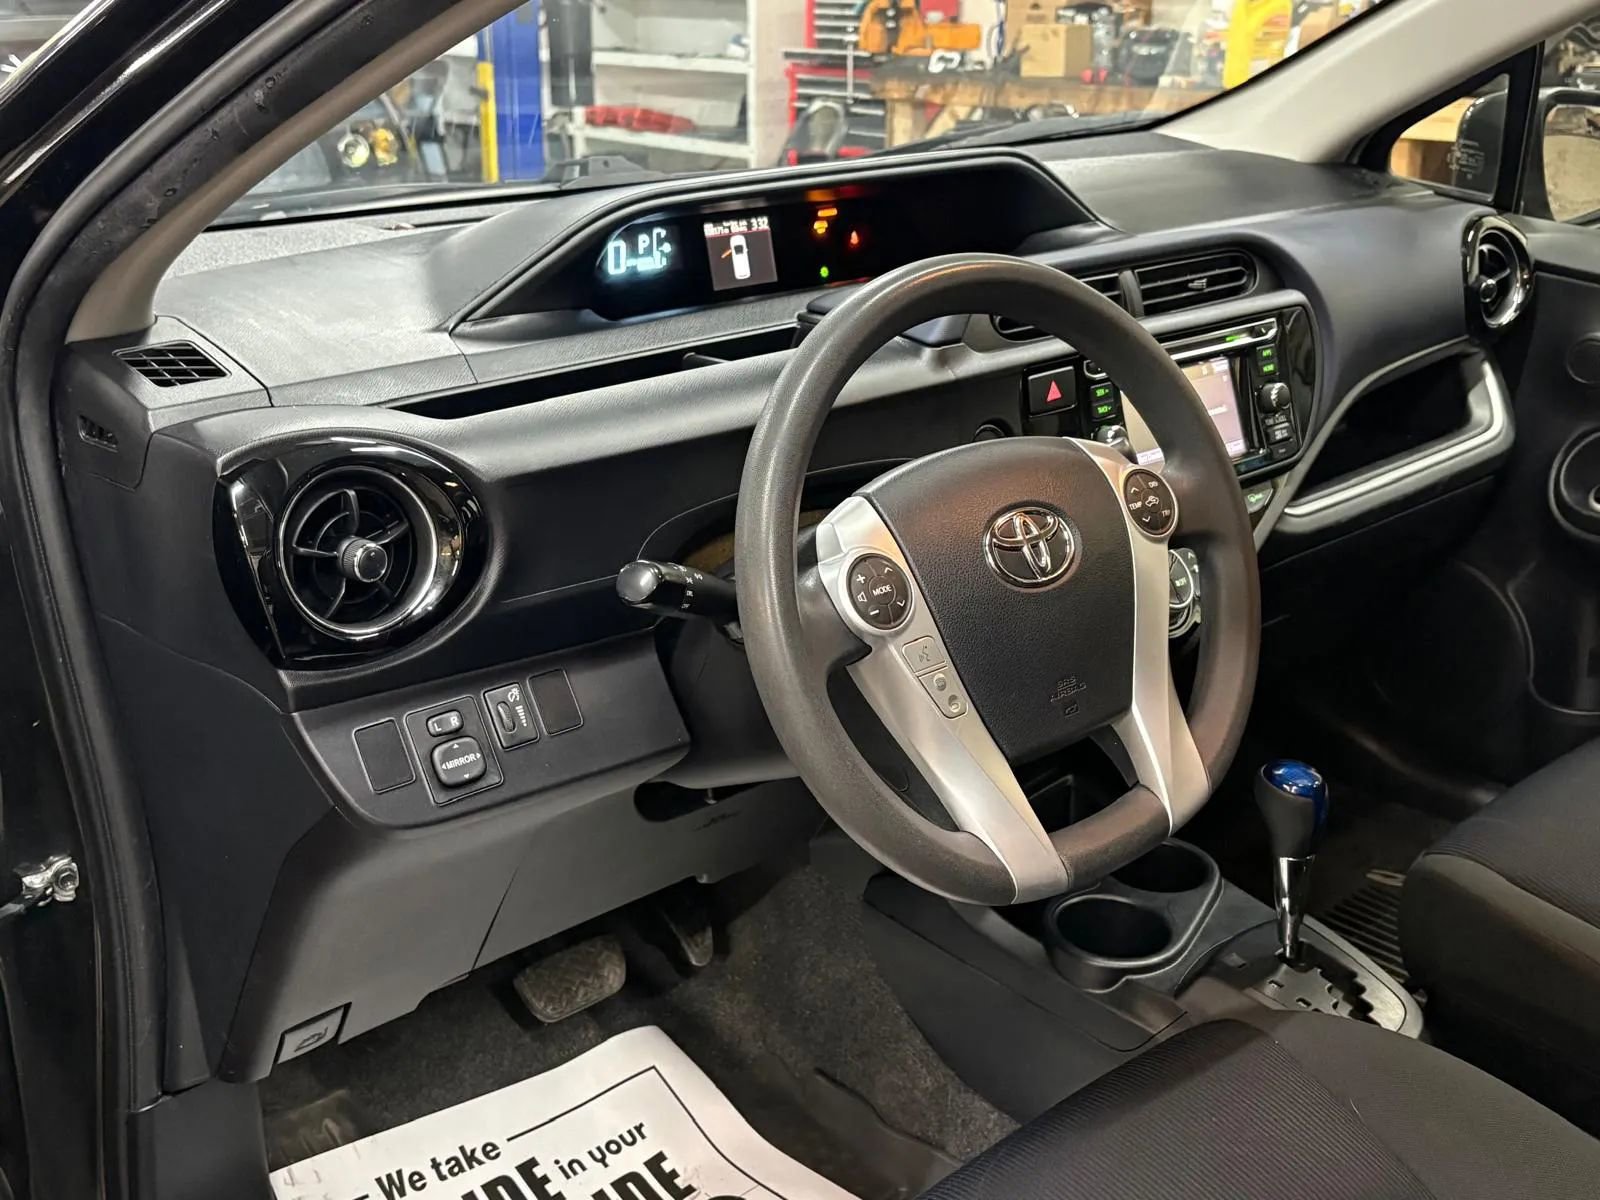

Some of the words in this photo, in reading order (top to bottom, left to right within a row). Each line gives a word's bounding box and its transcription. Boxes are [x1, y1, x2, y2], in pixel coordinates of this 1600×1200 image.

[607, 240, 627, 275] 0
[872, 585, 892, 597] MODE
[433, 722, 442, 732] L
[450, 716, 460, 727] R
[446, 753, 476, 770] MIRROR
[554, 1158, 588, 1181] in
[588, 1122, 648, 1169] your
[375, 1168, 428, 1200] We
[430, 1141, 502, 1182] take
